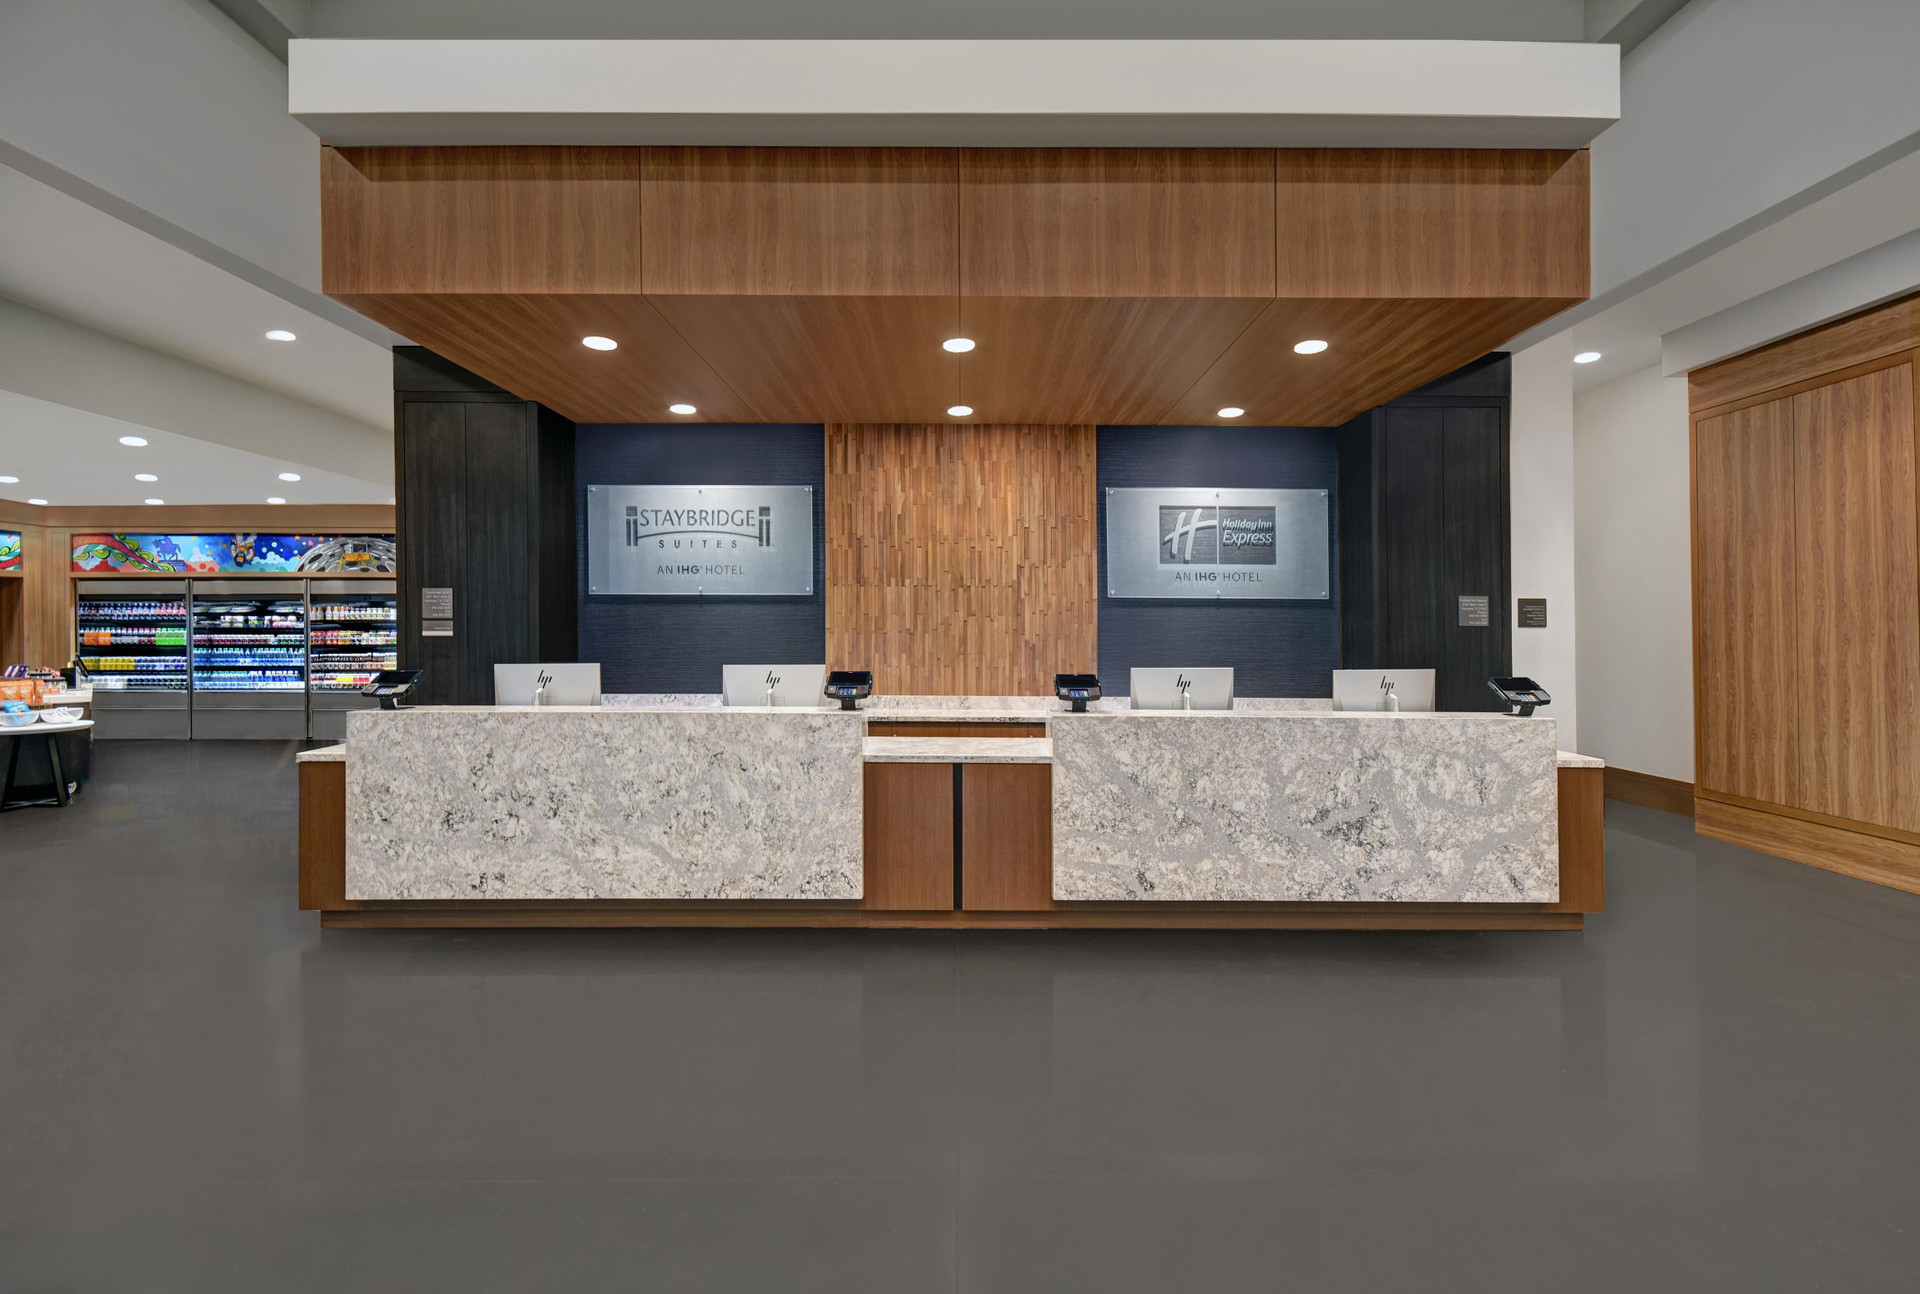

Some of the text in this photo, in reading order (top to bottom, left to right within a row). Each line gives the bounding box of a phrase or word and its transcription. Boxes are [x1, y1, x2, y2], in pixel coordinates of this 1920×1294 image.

[639, 509, 756, 527] STAYBRIDGE
[1222, 518, 1272, 530] Holiday Inn
[658, 539, 738, 549] SUITES
[1222, 530, 1273, 546] Express
[656, 565, 673, 575] AN
[705, 565, 745, 575] HOTEL
[1174, 571, 1191, 582] AN
[1223, 572, 1263, 582] HOTEL
[538, 669, 553, 689] hp
[766, 670, 781, 689] hp
[1176, 674, 1191, 694] hp
[1380, 675, 1395, 695] hp
